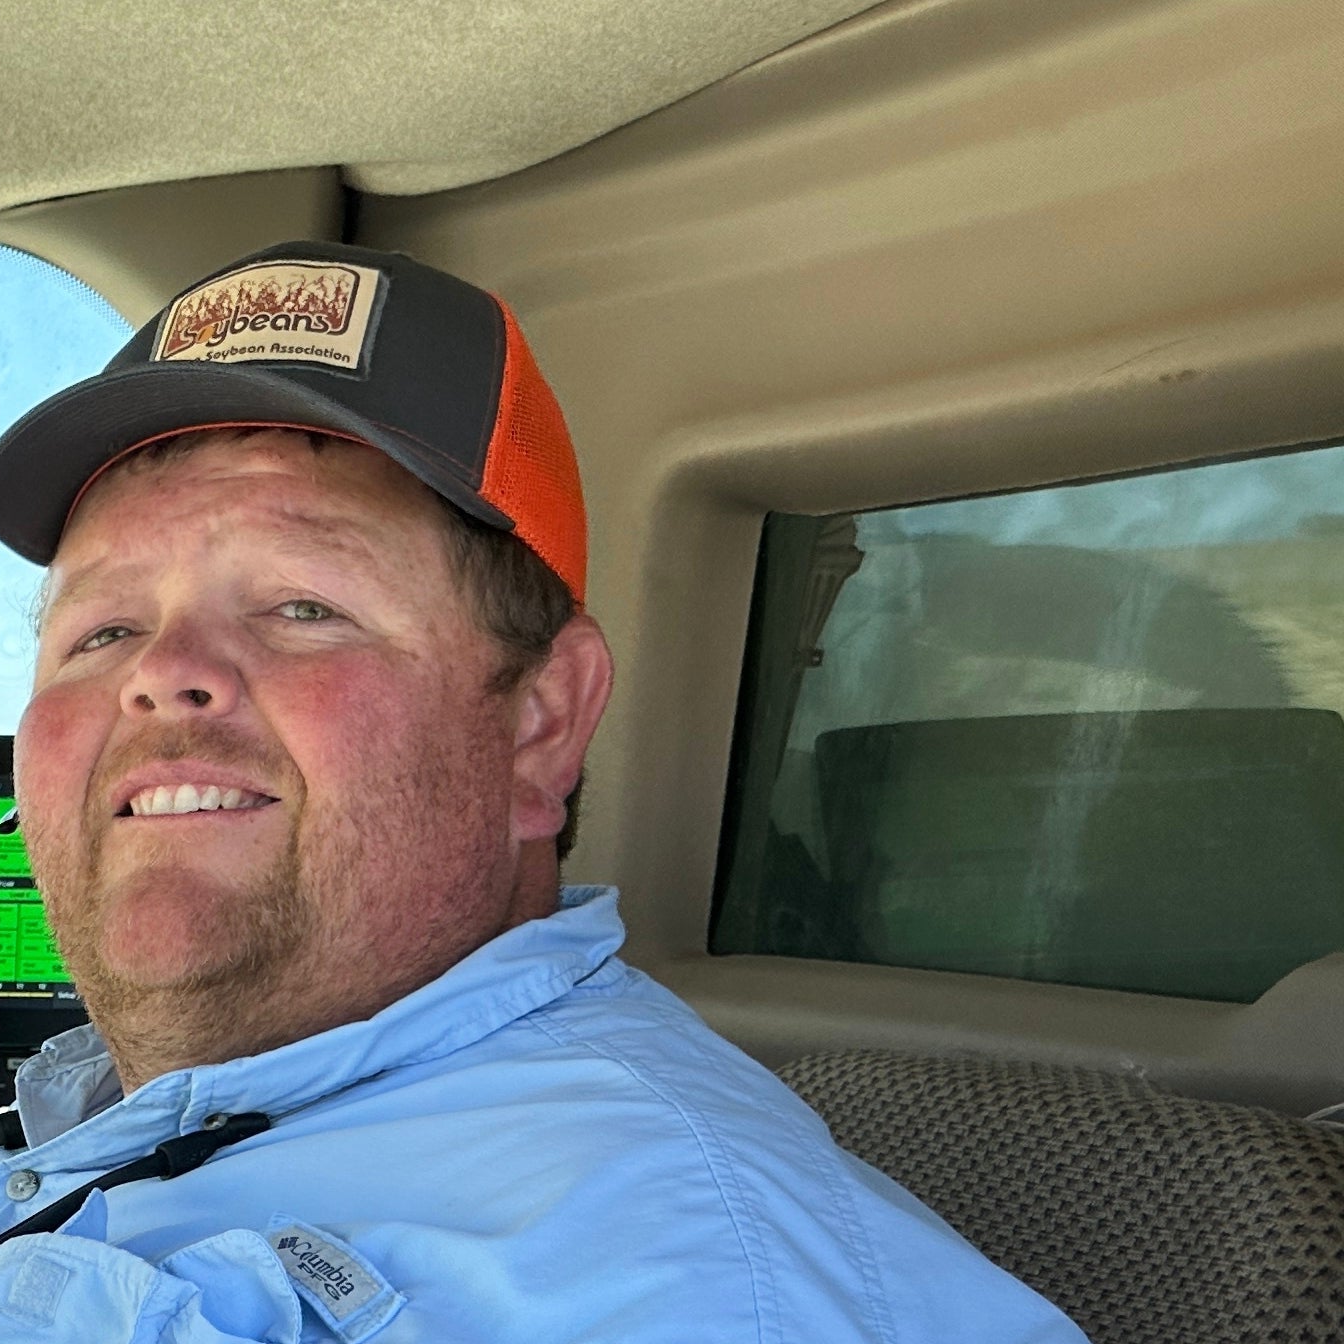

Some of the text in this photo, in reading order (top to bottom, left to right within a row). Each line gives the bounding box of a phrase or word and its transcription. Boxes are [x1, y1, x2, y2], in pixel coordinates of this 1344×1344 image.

[182, 304, 330, 348] Soybeans
[205, 342, 351, 364] Soybean Association
[290, 1240, 357, 1297] Columbia
[296, 1263, 342, 1301] PFG
